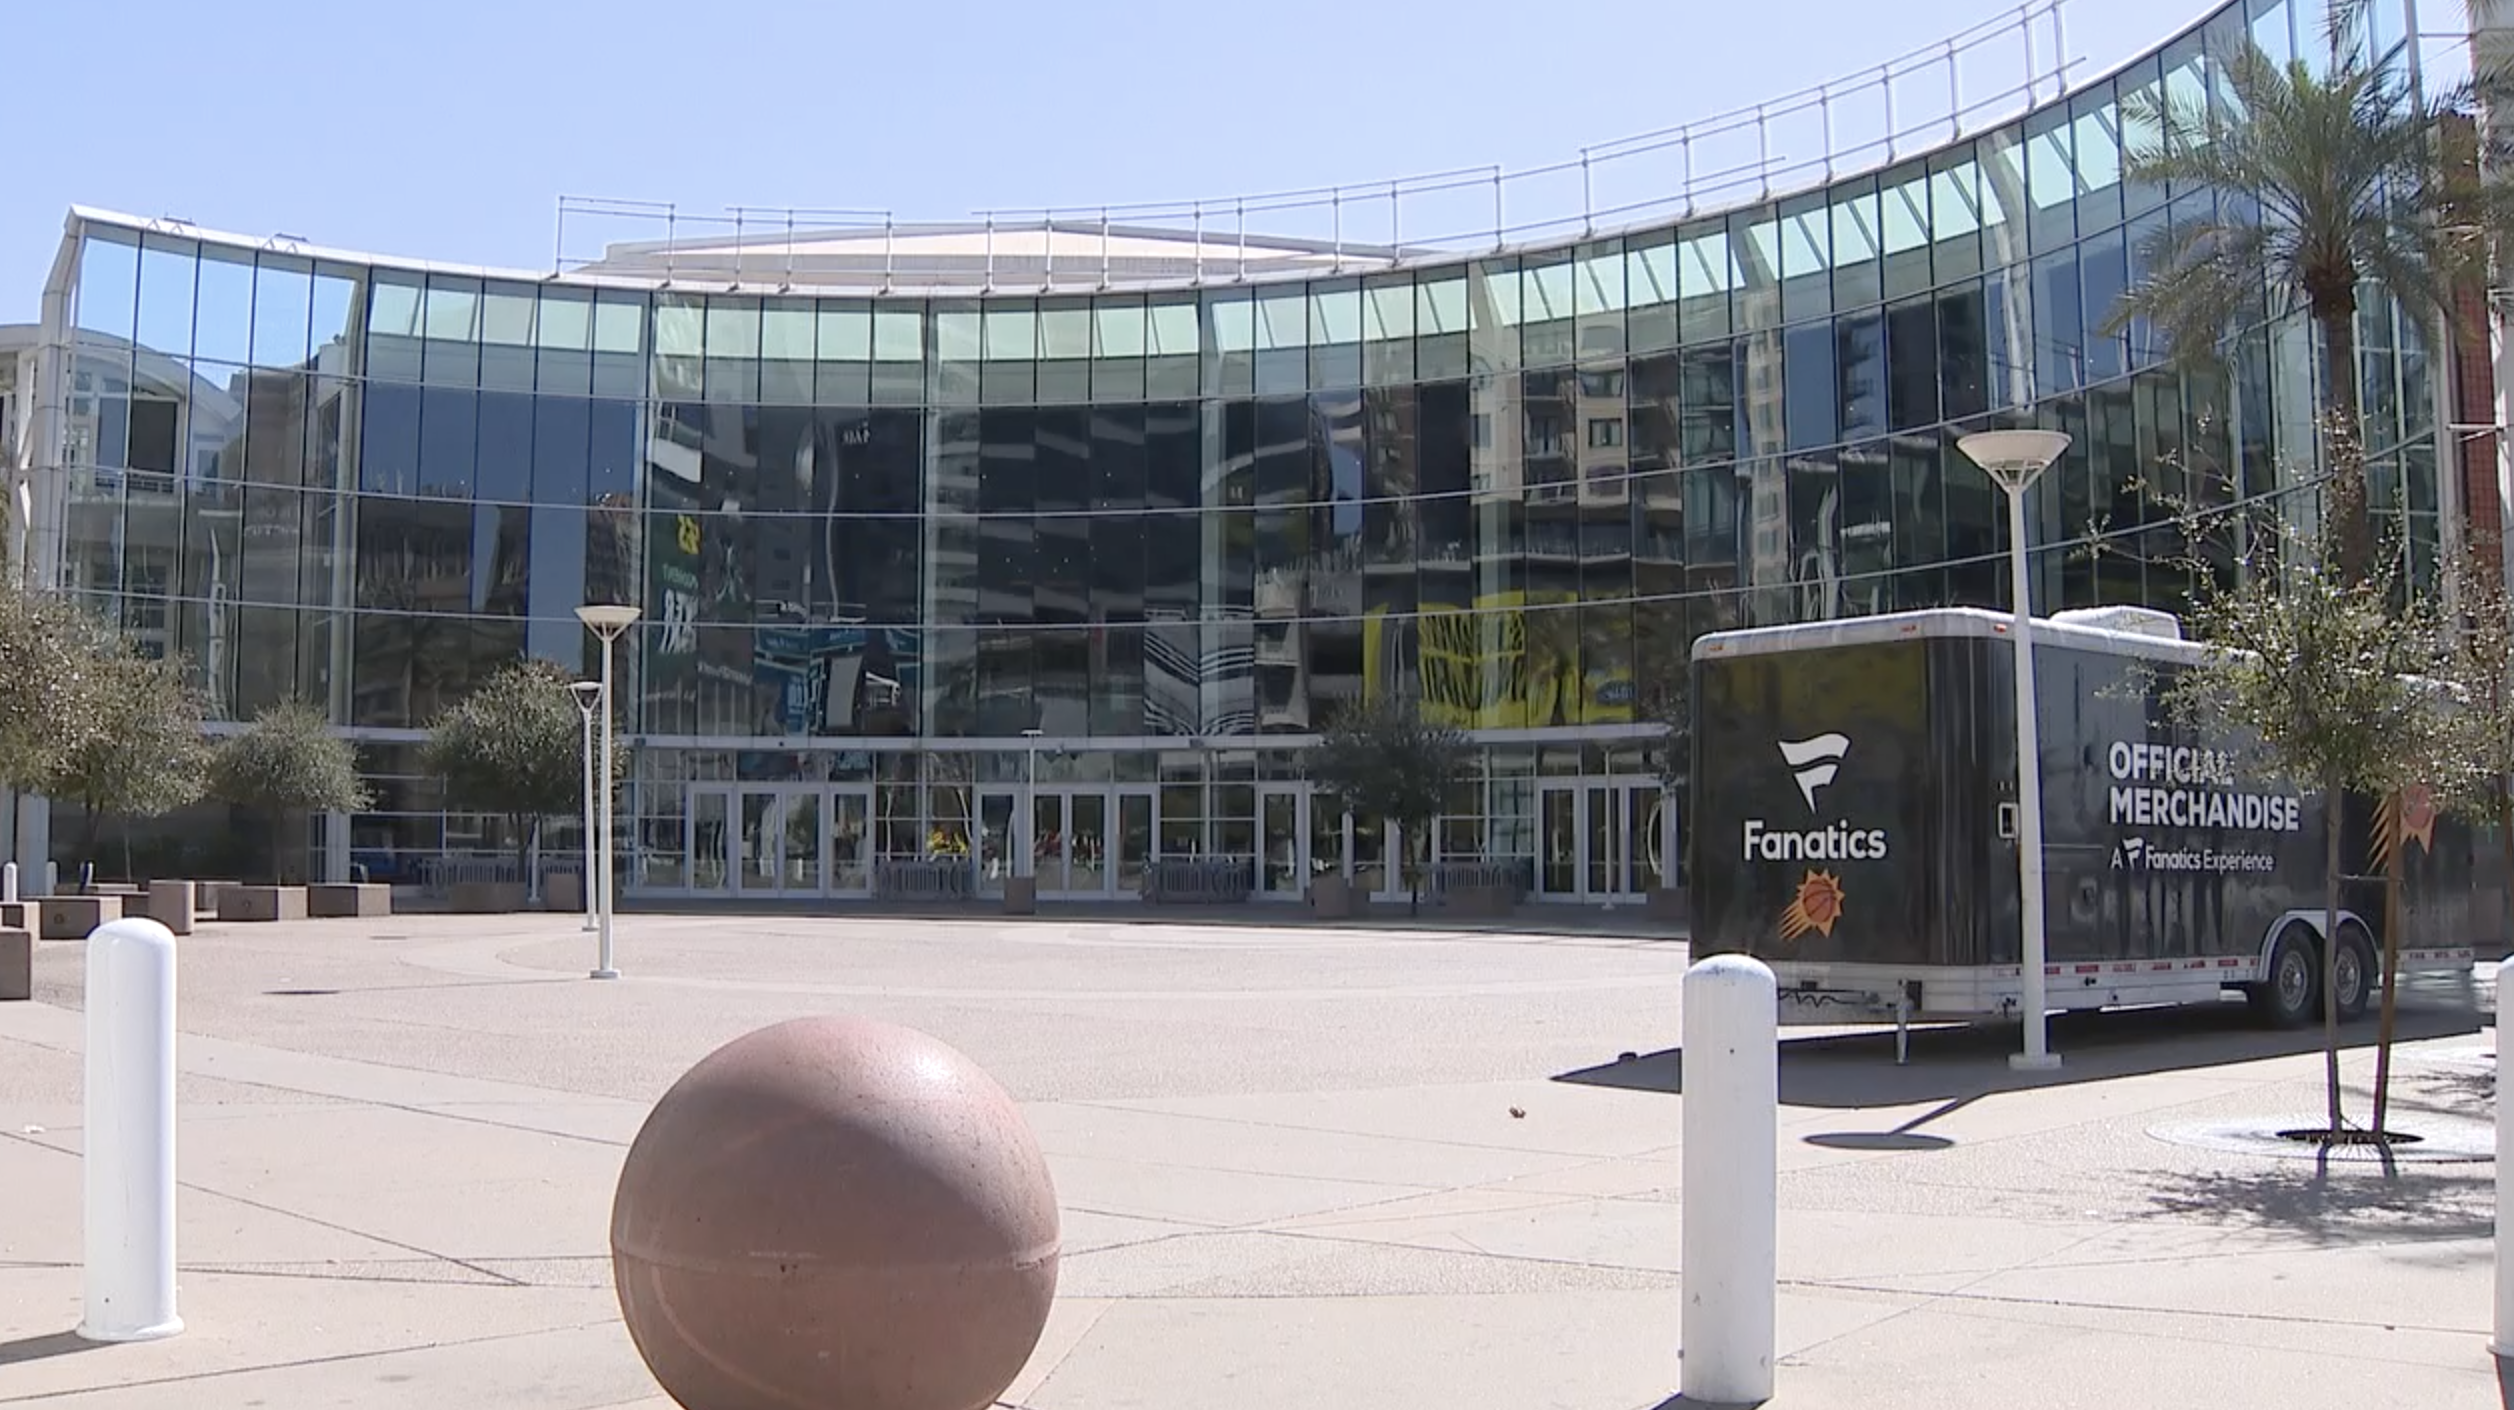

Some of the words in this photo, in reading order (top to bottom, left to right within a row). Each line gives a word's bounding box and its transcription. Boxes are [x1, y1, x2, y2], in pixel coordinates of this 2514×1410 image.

[2109, 740, 2235, 786] OFFICIAL
[2110, 786, 2300, 831] MERCHANDISE
[1743, 819, 1888, 861] Fanatics
[2110, 847, 2123, 870] A
[2145, 845, 2201, 871] Fanatics
[2203, 849, 2275, 875] Experience
